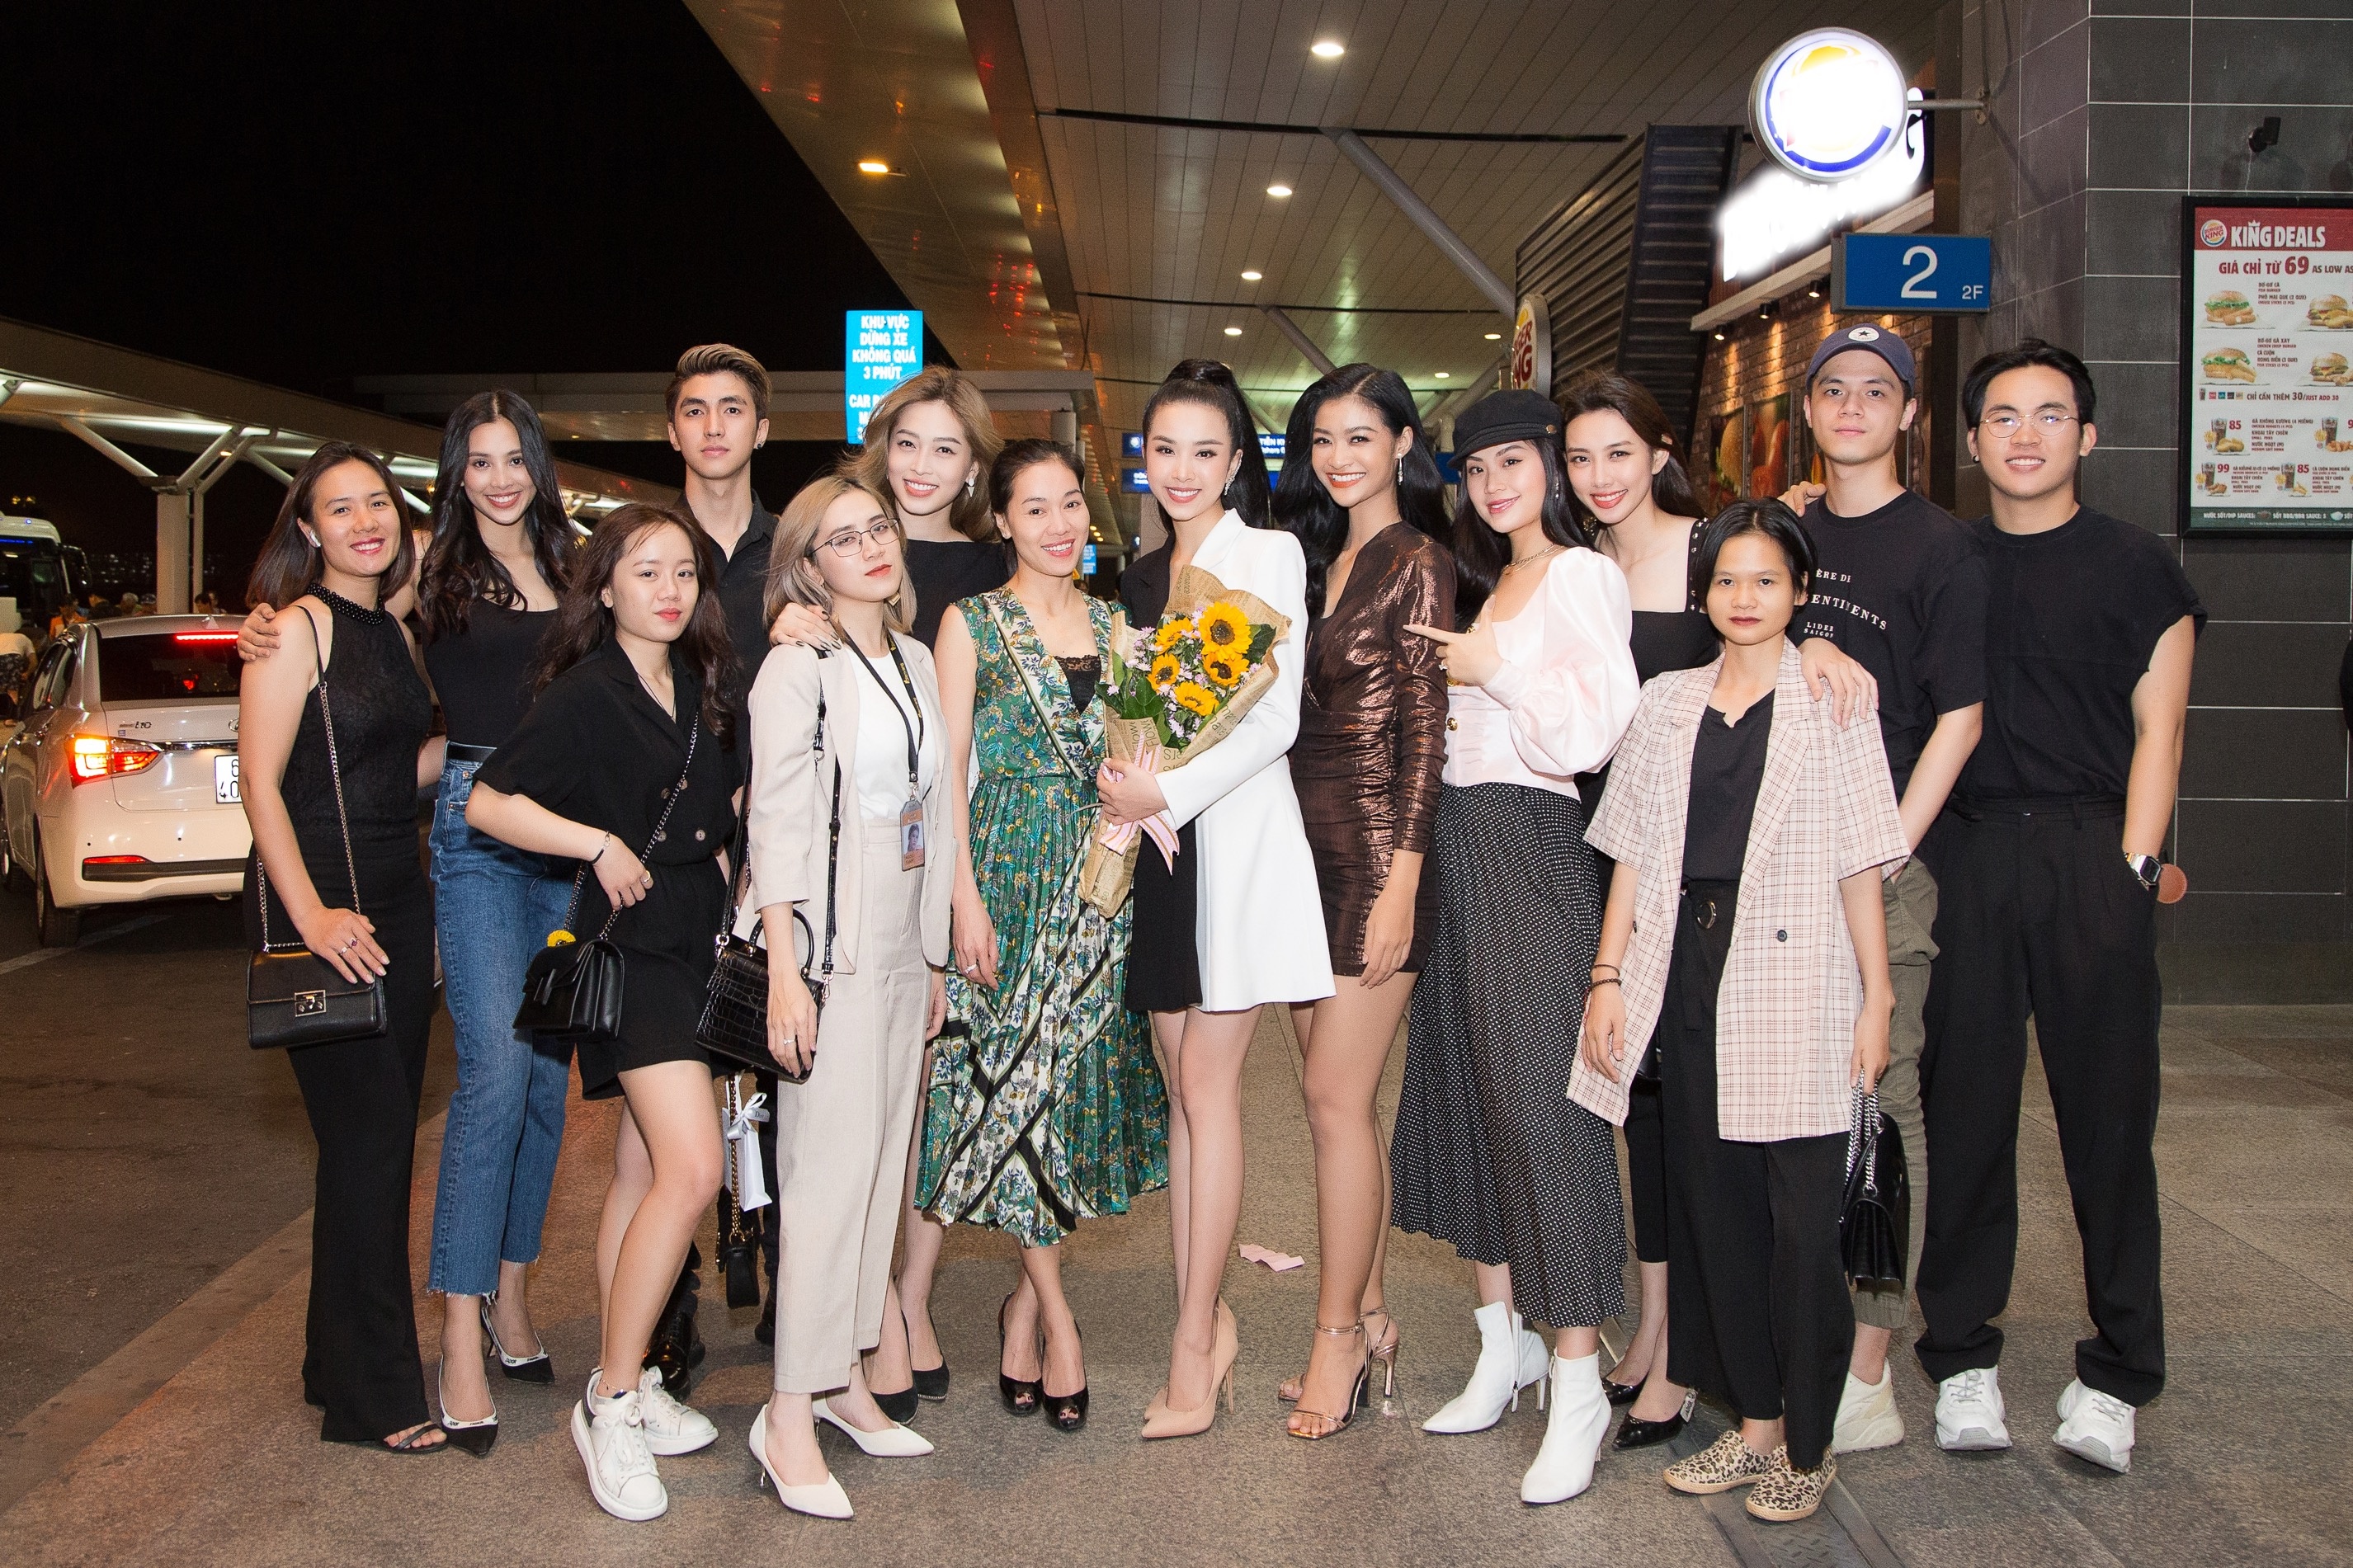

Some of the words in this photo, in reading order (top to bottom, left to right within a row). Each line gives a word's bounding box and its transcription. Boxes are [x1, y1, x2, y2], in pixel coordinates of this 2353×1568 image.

[2231, 226, 2271, 247] KING
[2274, 226, 2326, 247] DEALS
[1901, 245, 1938, 299] 2
[1962, 285, 1983, 299] 2F
[2219, 260, 2239, 275] GIÁ
[2243, 258, 2261, 275] CHỈ
[2285, 256, 2309, 275] 69
[2312, 266, 2322, 274] AS
[2325, 266, 2342, 274] LOW
[861, 315, 884, 329] KHU
[893, 332, 908, 346] XE
[852, 346, 891, 363] KHÔNG
[893, 346, 917, 363] QUÁ
[863, 367, 870, 379] 3
[872, 363, 903, 379] PHÚT
[849, 394, 871, 408] CAR
[2228, 420, 2242, 430] 85
[2217, 464, 2229, 473] 99
[2297, 464, 2309, 473] 85
[1815, 568, 1837, 580] ÈRE
[1811, 594, 1887, 630] ENTIENTS
